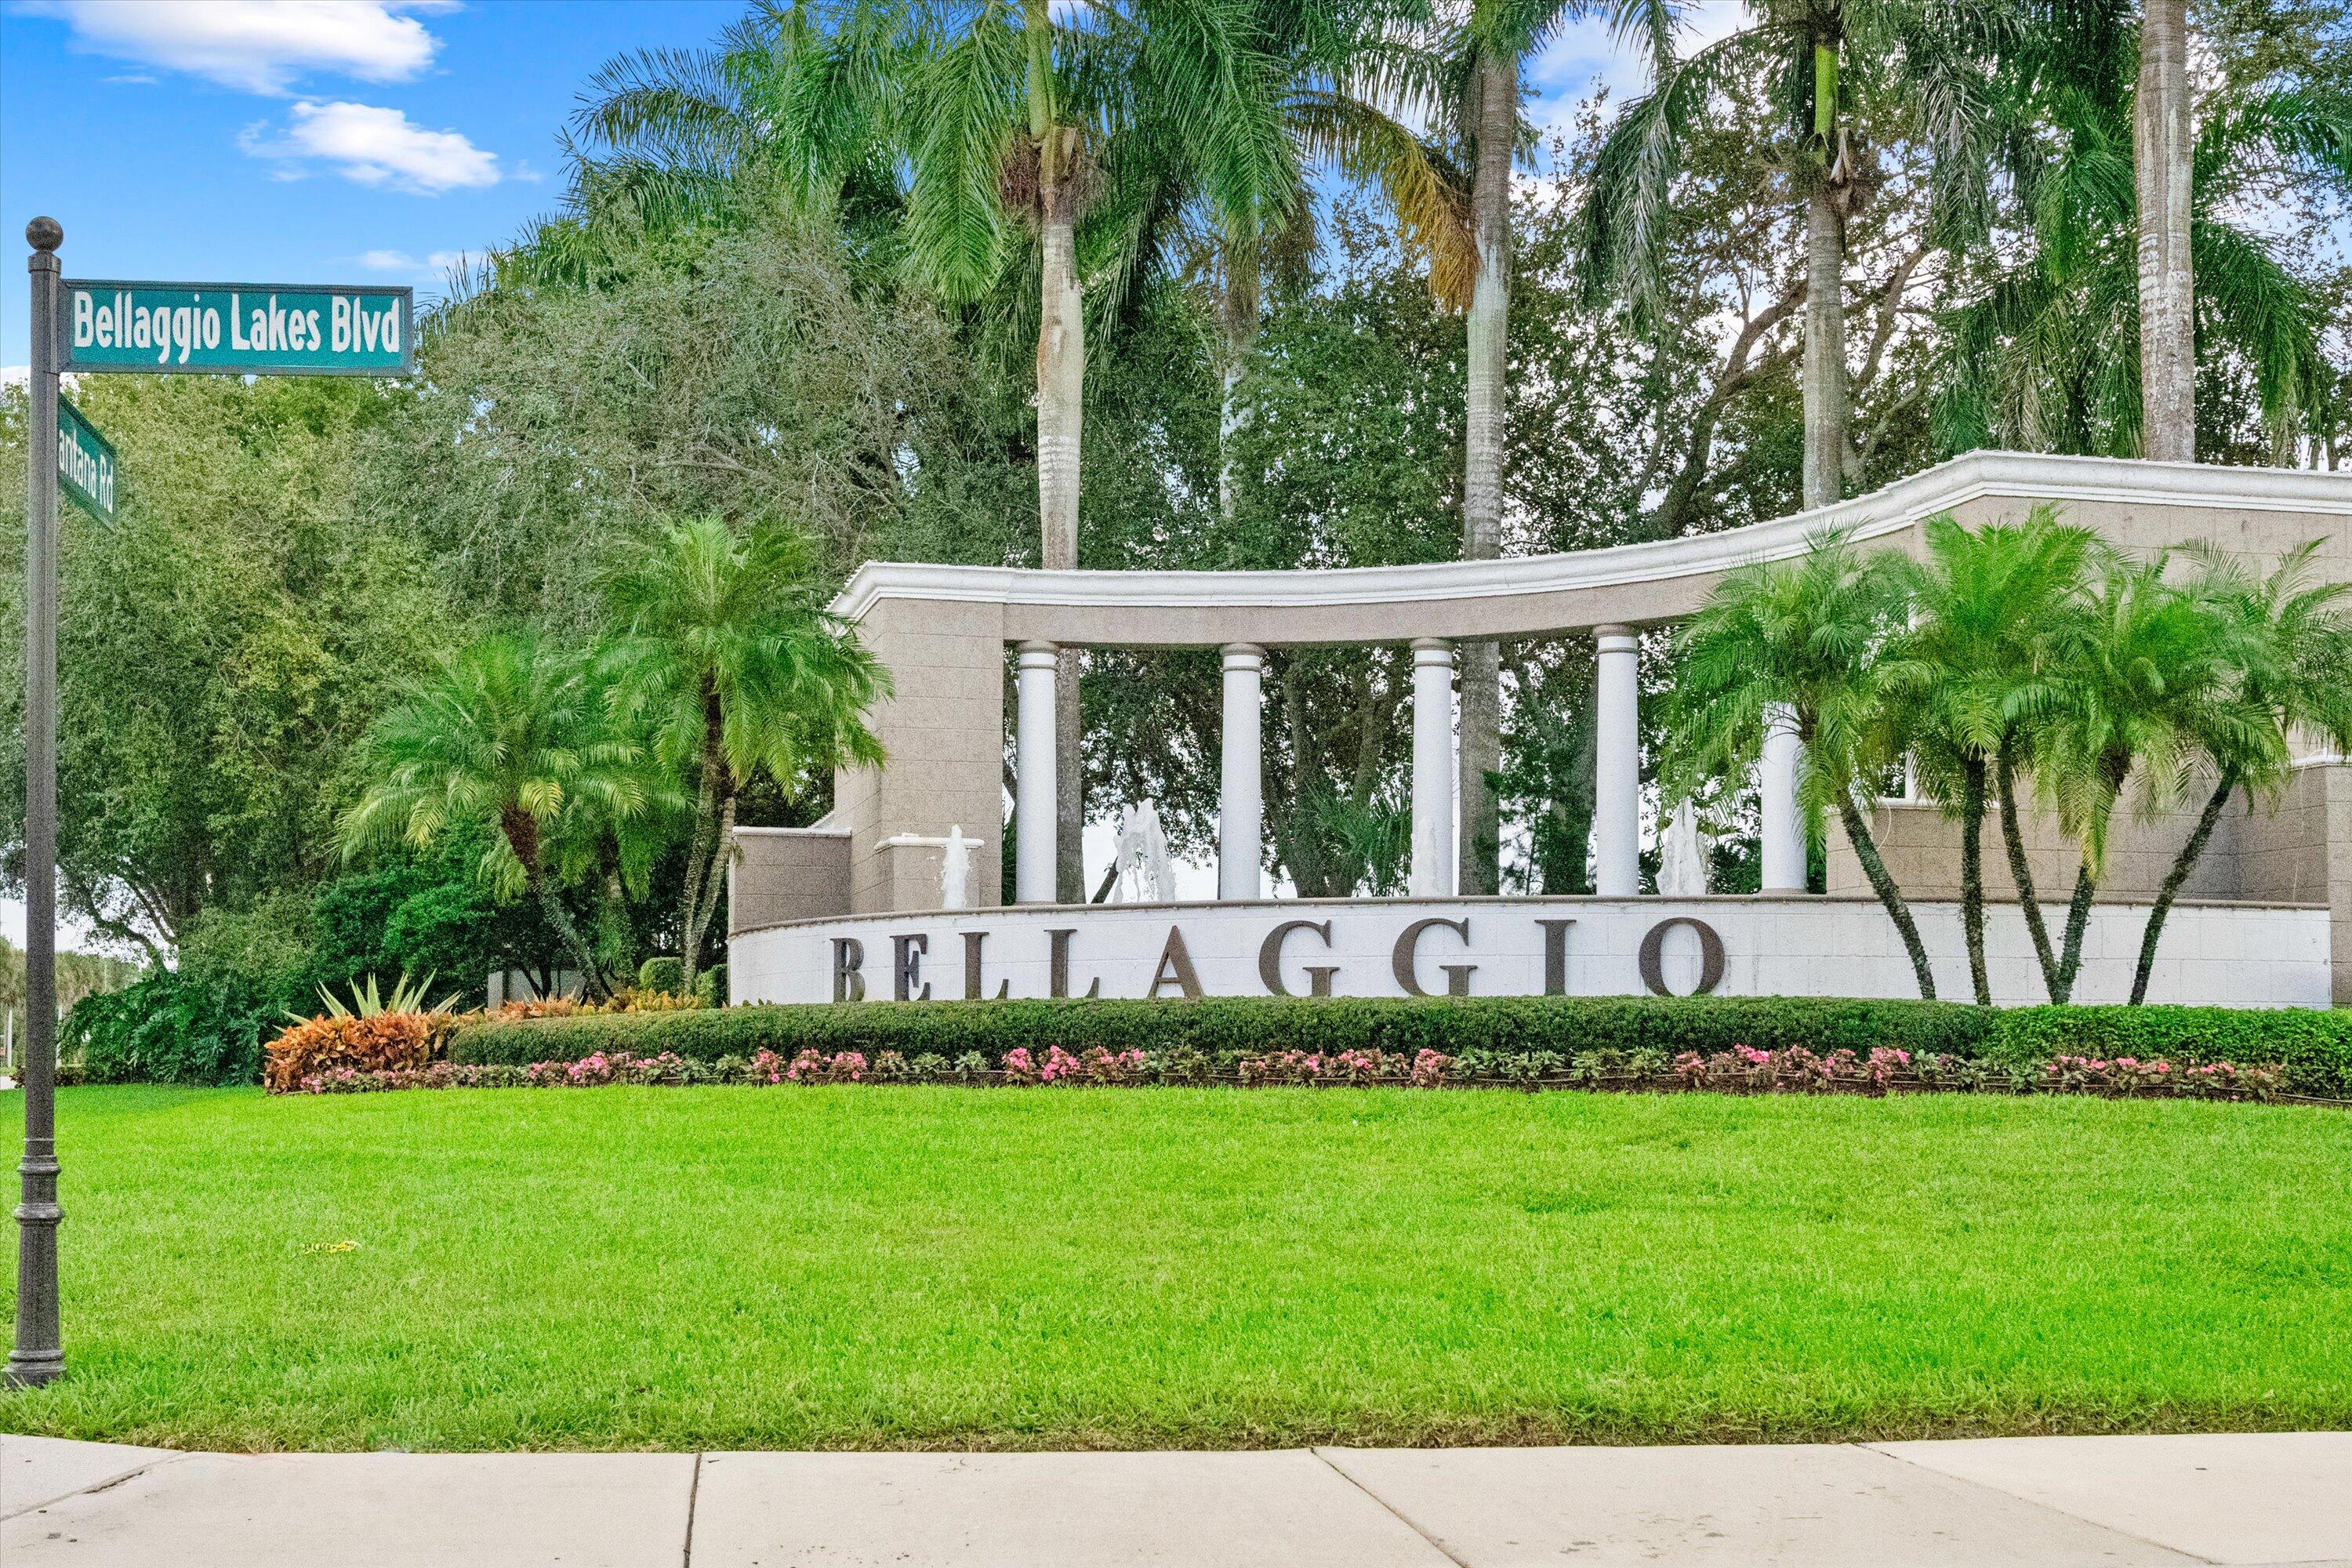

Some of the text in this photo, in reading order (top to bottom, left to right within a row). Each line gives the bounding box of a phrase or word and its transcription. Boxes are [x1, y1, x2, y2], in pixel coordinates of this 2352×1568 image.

[74, 291, 400, 364] Bellaggio Lakes Blvd
[59, 429, 114, 514] antana Rd
[829, 916, 1725, 1004] BELLAGGIO
